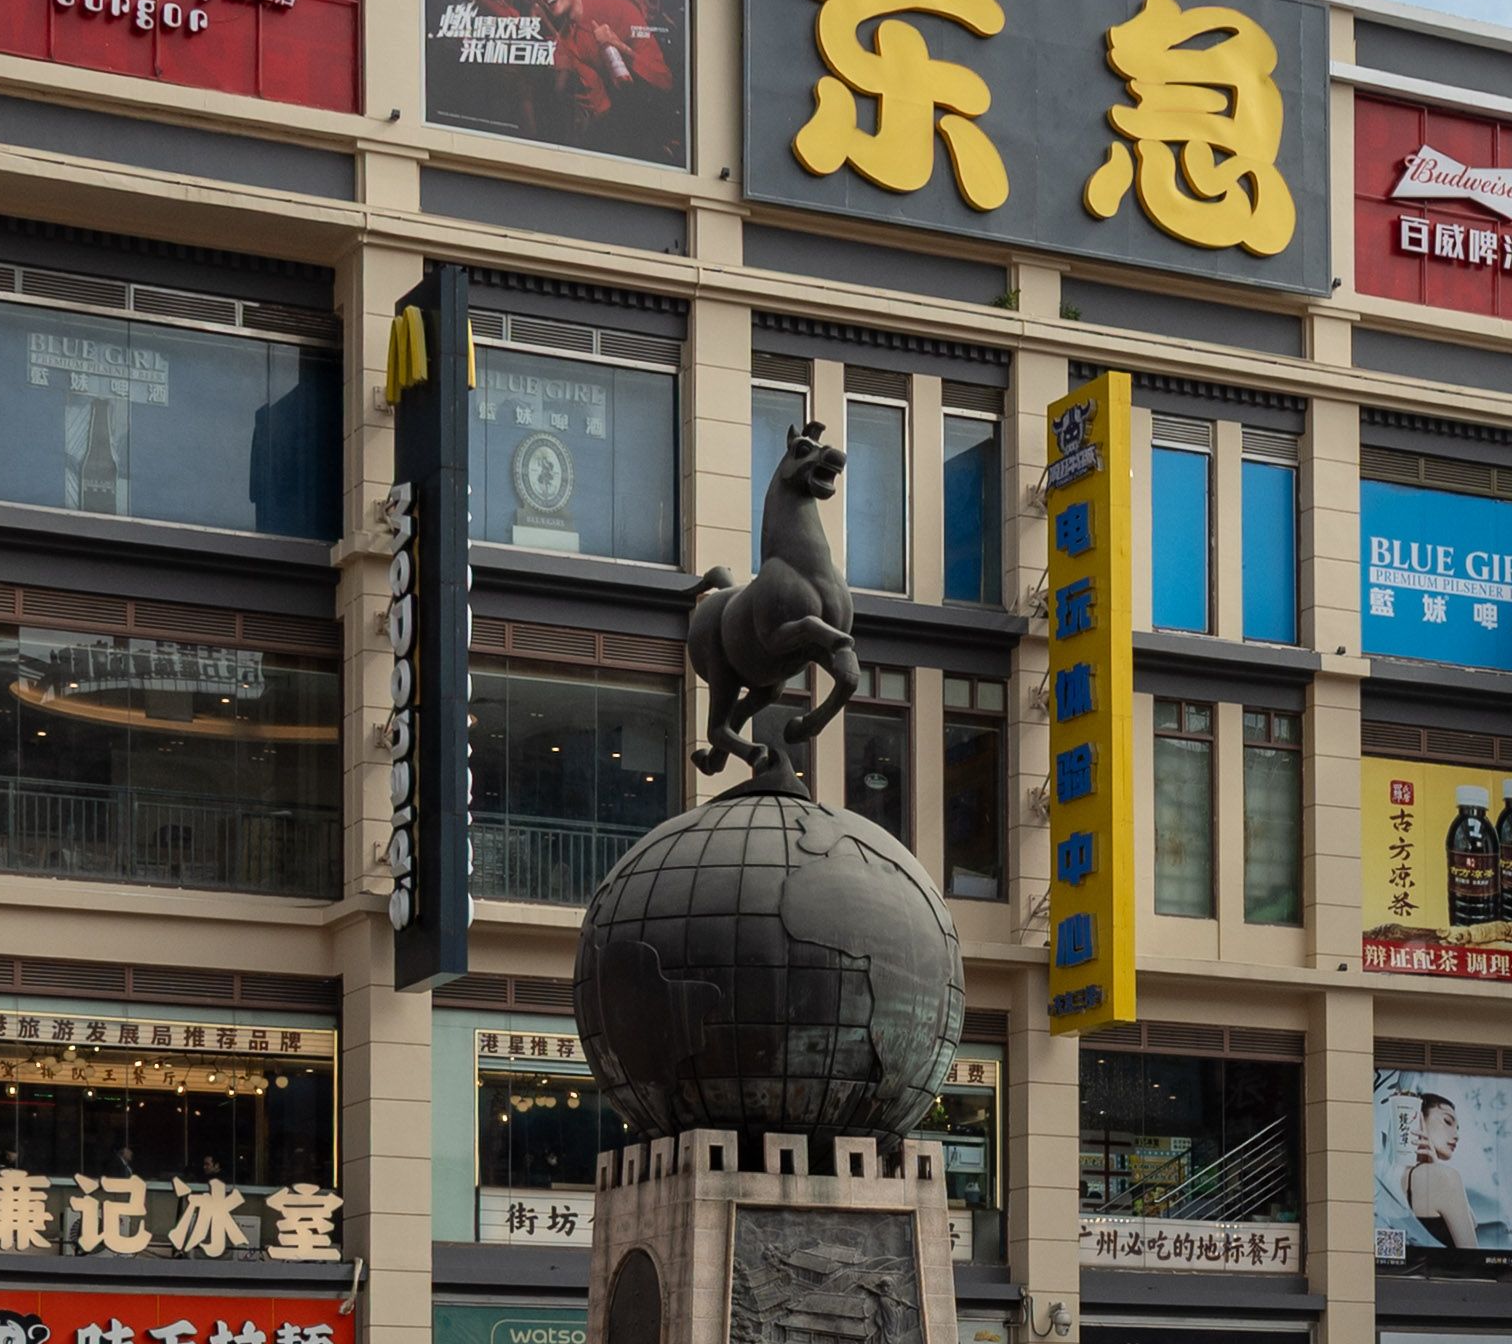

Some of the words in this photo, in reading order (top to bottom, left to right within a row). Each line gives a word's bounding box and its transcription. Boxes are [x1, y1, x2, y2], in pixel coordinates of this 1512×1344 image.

[438, 1, 543, 40] 燃情欢聚
[459, 38, 556, 66] 来杯百威
[1369, 535, 1456, 577] BLUE
[1375, 569, 1440, 589] PREMIUM
[1442, 578, 1504, 598] PILSENER
[1055, 501, 1097, 969] 电玩体验中心
[1386, 807, 1421, 918] 古方凉茶
[480, 1032, 576, 1058] 港星推荐
